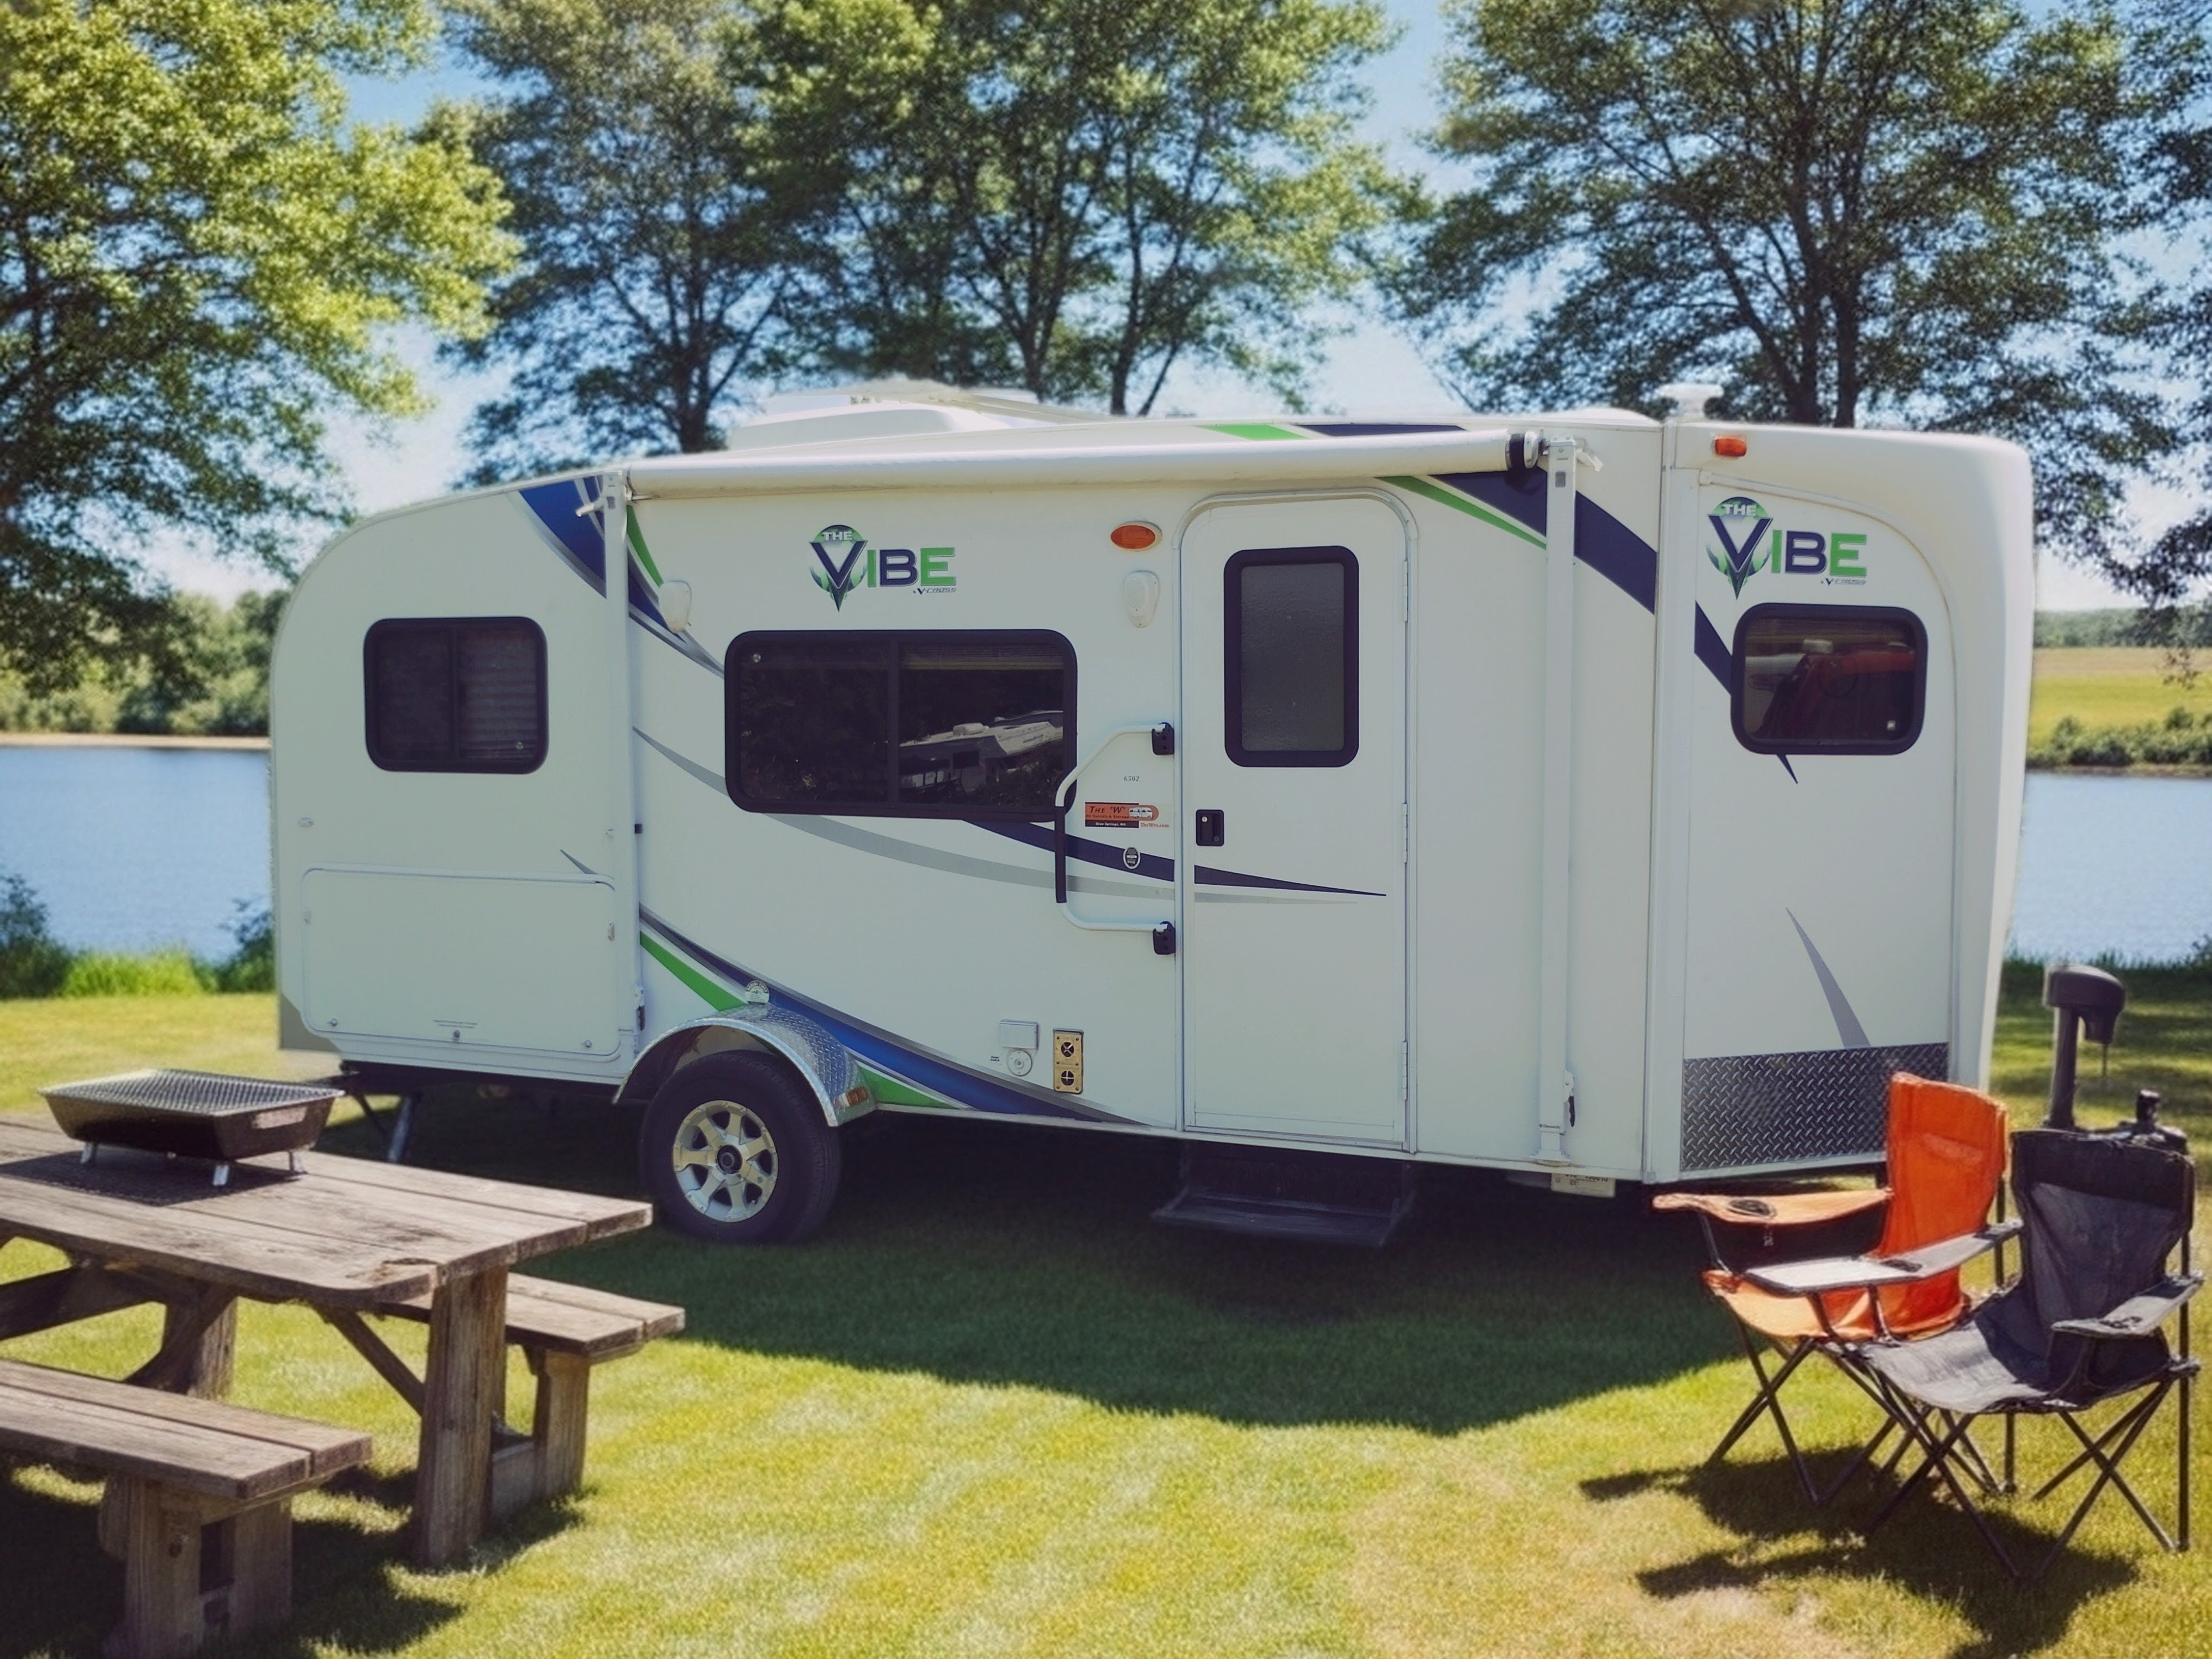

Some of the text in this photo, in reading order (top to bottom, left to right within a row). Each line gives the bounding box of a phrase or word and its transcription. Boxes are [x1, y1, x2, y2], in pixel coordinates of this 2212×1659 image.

[1722, 504, 1757, 516] THE
[822, 531, 853, 541] THE
[1708, 514, 1867, 578] VIBE
[809, 540, 957, 589] VIBE
